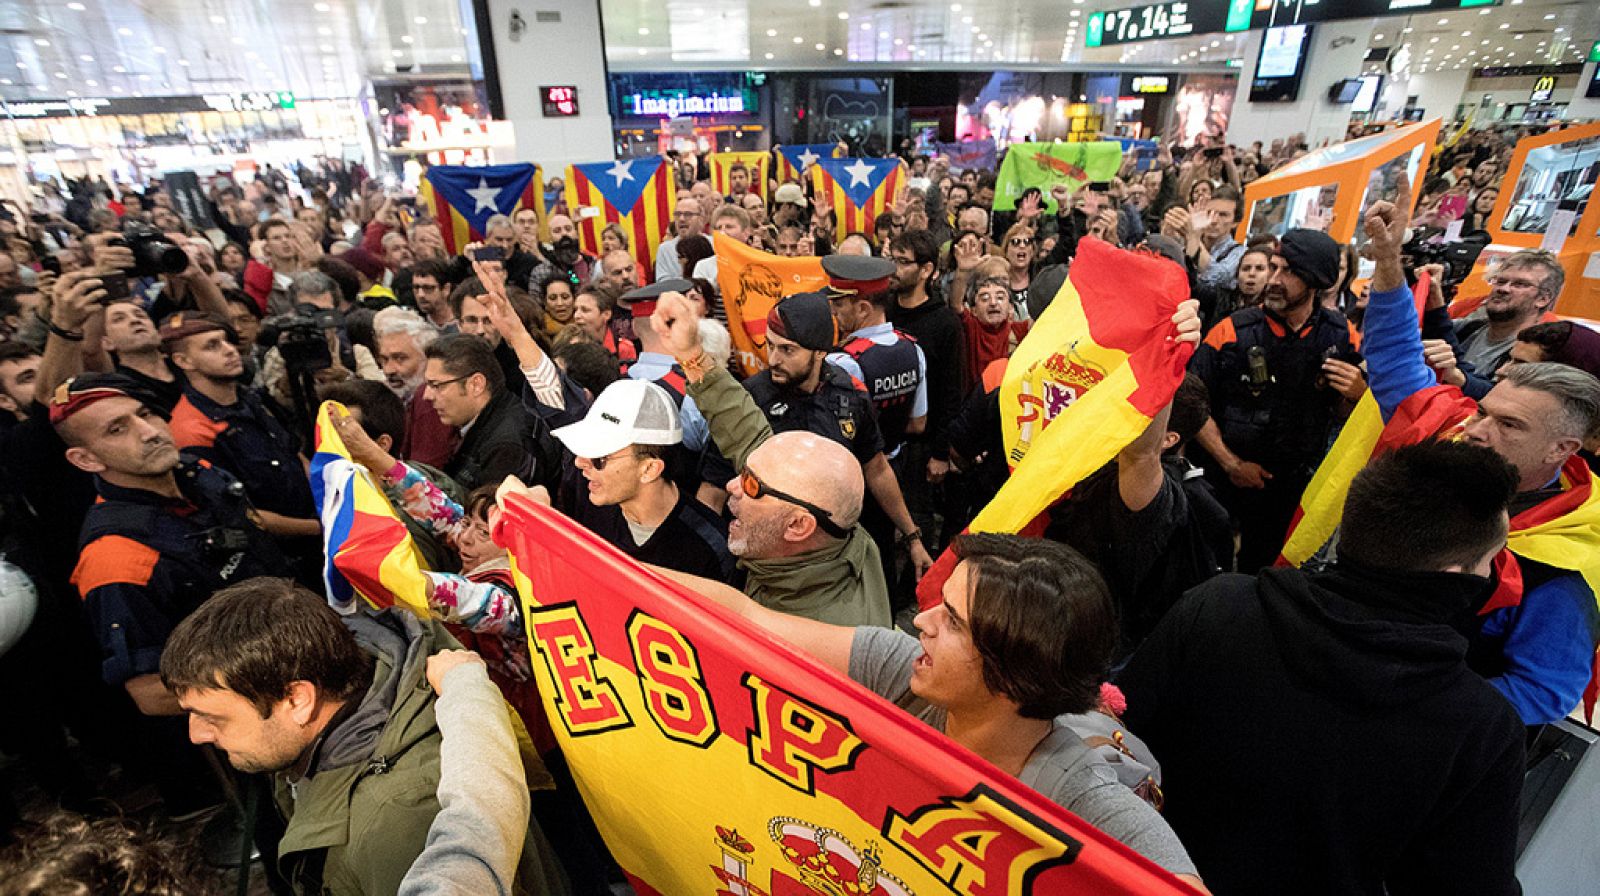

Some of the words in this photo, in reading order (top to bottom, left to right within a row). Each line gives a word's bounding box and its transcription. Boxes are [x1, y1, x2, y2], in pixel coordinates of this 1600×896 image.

[1139, 4, 1169, 37] 14
[632, 91, 744, 117] Imaginarium
[874, 369, 918, 394] POLICIA
